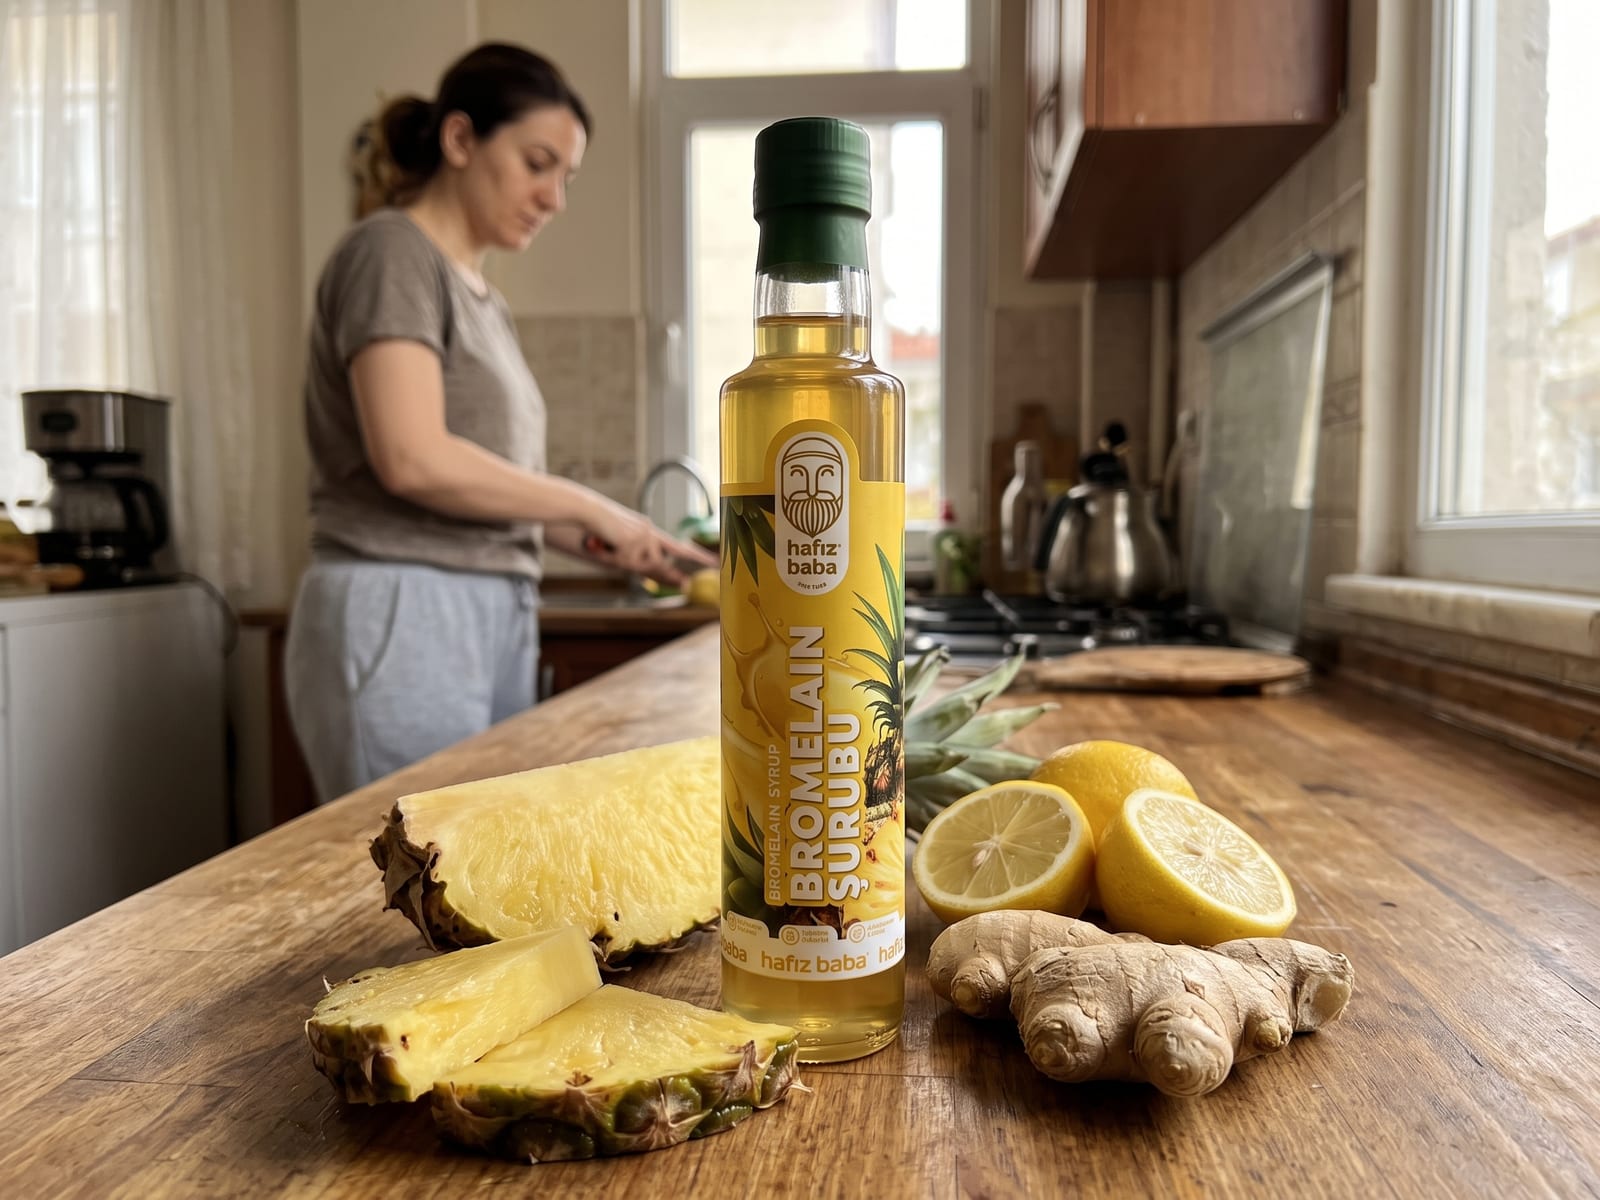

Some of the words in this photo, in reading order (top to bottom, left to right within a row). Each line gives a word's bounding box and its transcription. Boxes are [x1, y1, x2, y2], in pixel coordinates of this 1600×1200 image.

[787, 558, 837, 575] baba
[768, 744, 780, 797] SYRUP
[789, 626, 824, 900] BROMELAIN
[827, 713, 868, 900] ŞURUBU
[768, 805, 780, 900] BROMELAIN
[816, 953, 867, 973] baba
